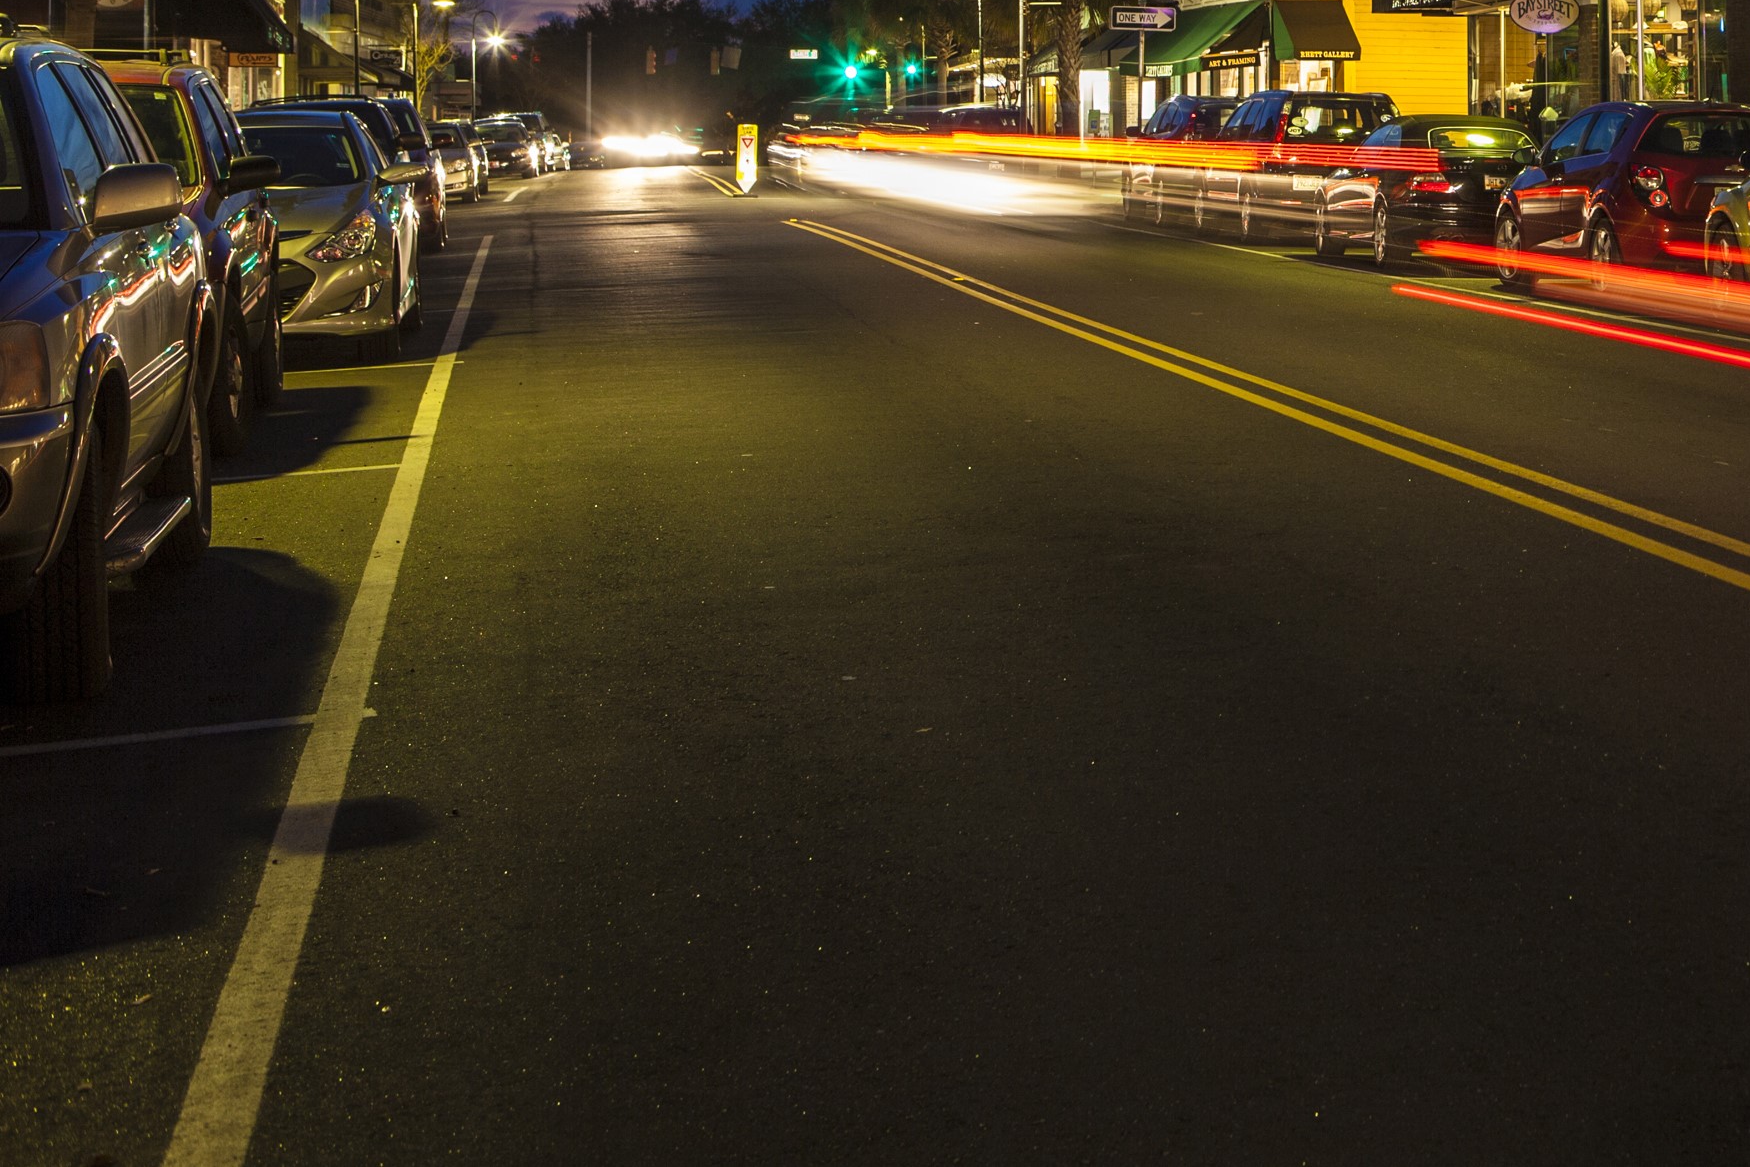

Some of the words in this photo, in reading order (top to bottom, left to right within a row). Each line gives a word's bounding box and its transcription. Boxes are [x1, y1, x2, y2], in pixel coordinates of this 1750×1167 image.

[1118, 13, 1136, 23] ONE
[1139, 13, 1157, 23] WAY
[1208, 60, 1220, 68] ART
[1222, 59, 1227, 67] &
[1228, 57, 1256, 66] FRAMING
